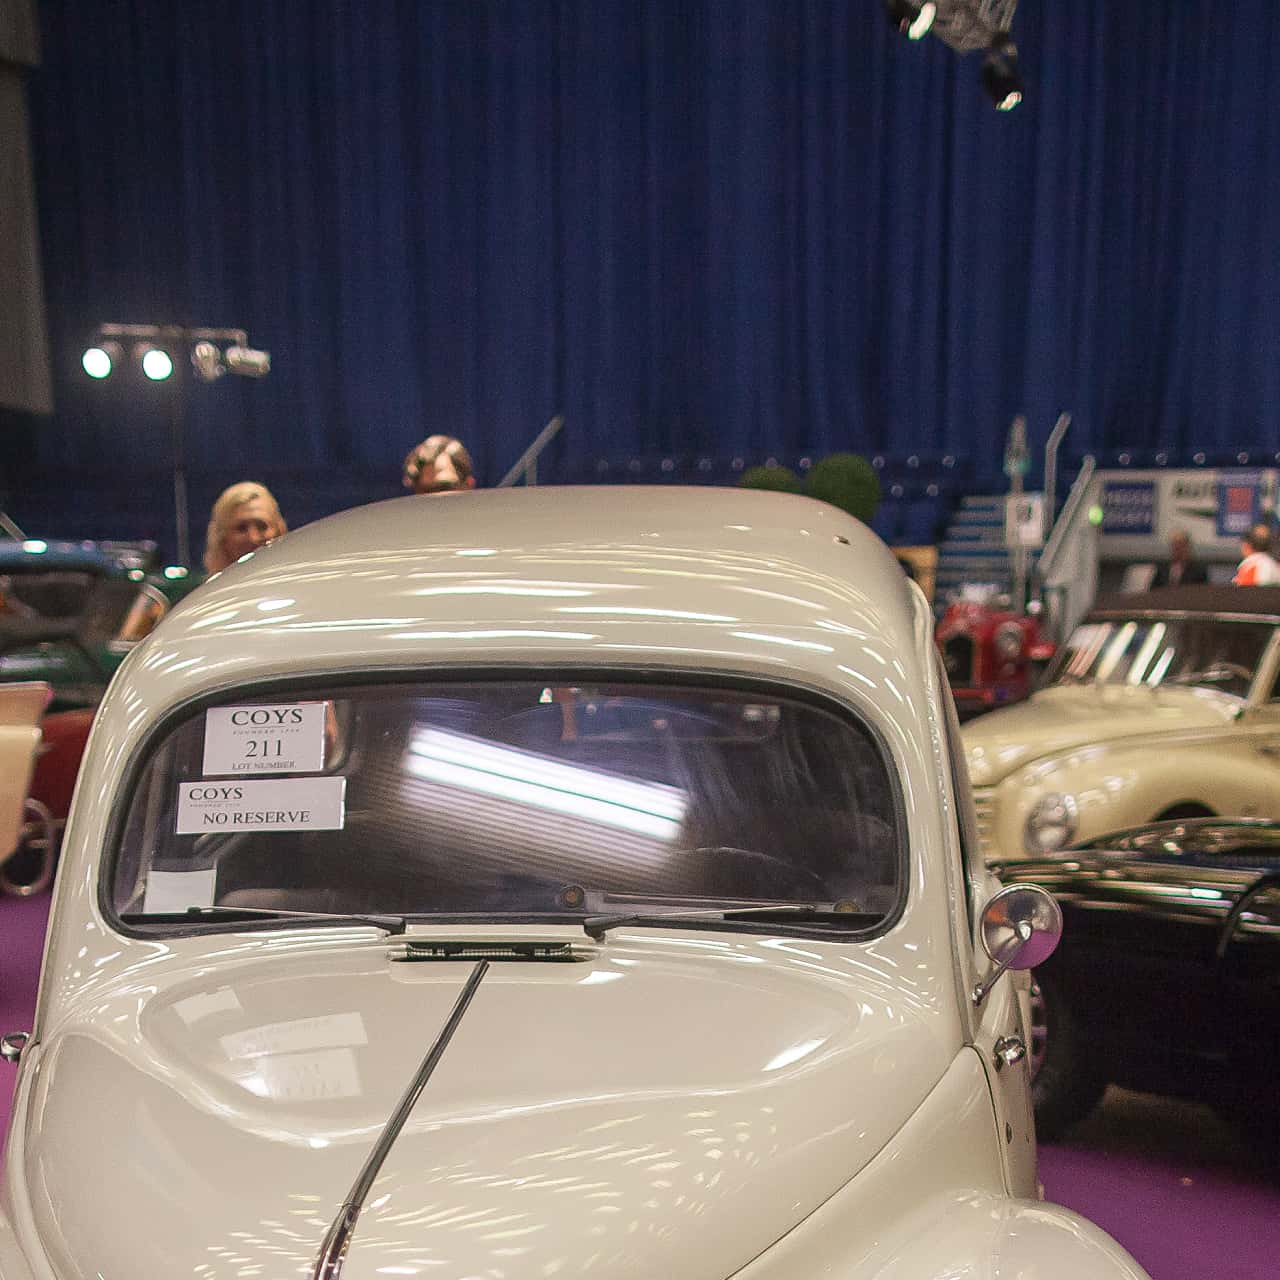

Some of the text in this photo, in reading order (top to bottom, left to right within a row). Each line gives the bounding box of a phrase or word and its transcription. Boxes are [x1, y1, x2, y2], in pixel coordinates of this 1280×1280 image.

[231, 708, 304, 726] COYS
[245, 739, 283, 758] 211
[231, 759, 297, 771] LOT NUMBER
[189, 787, 244, 801] COYS
[202, 810, 312, 825] NO RESERVE
